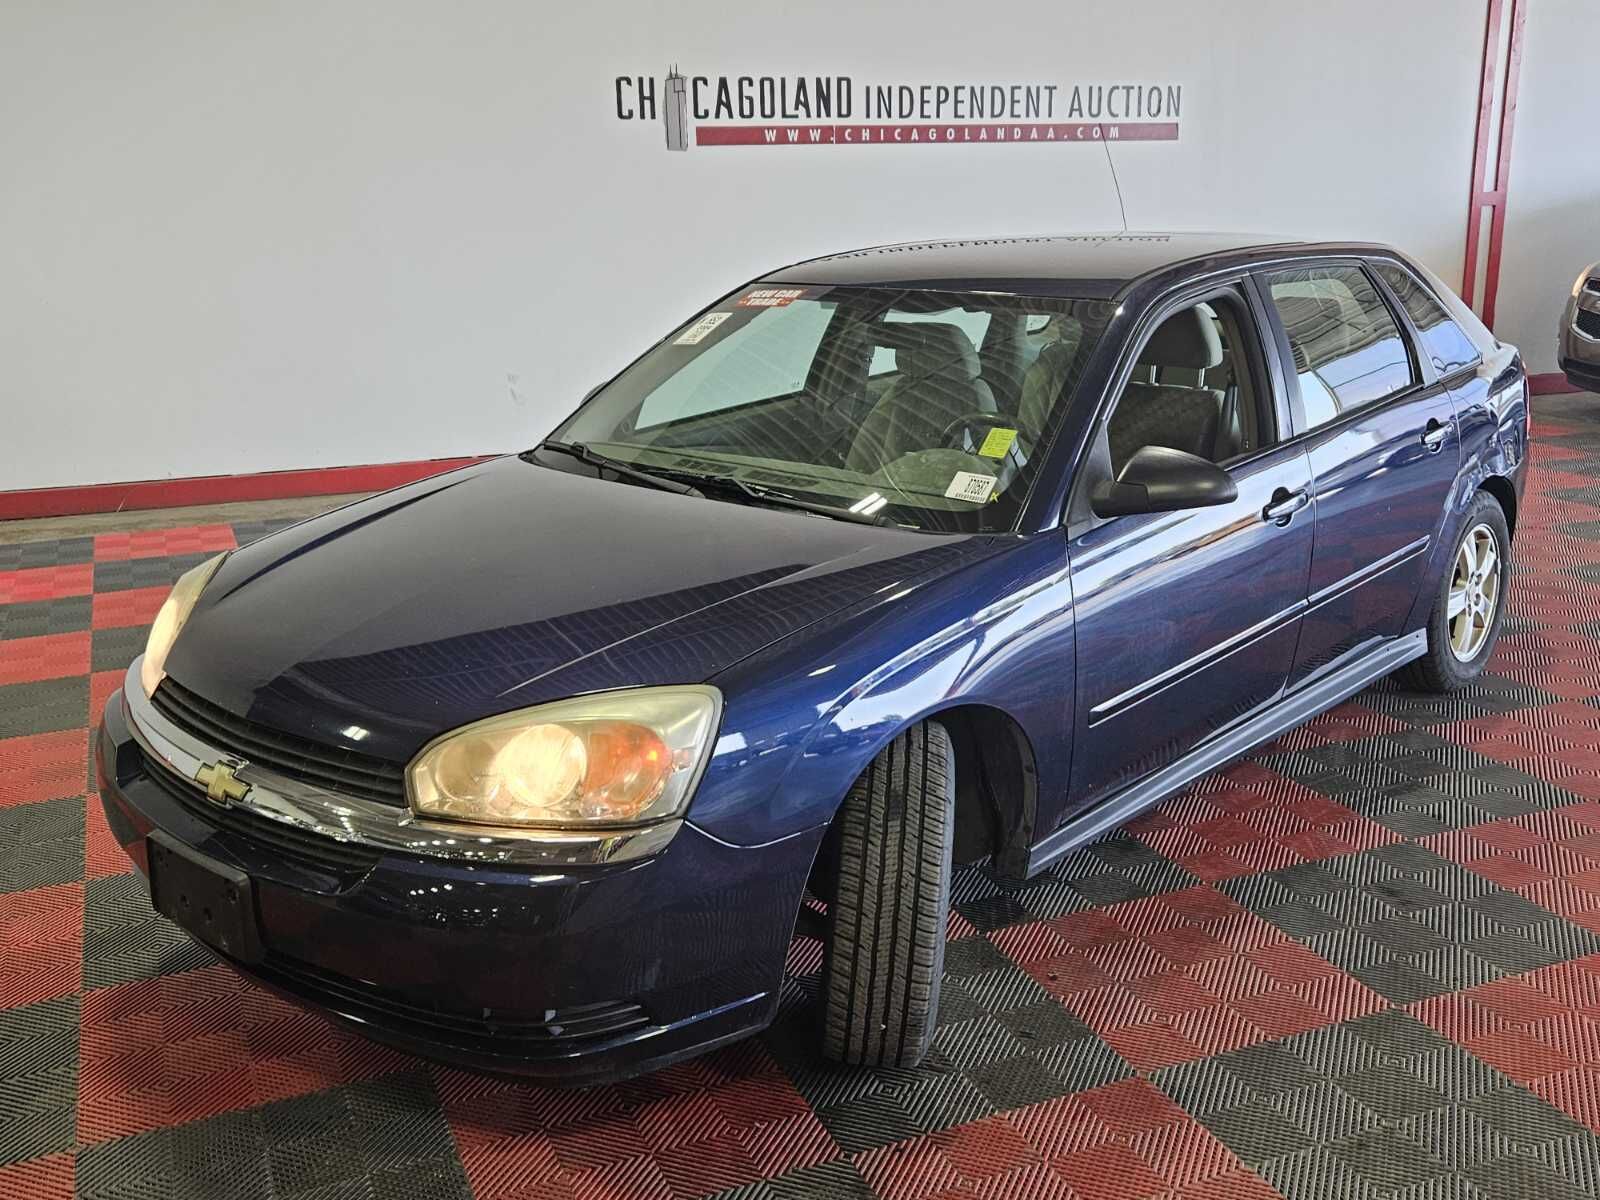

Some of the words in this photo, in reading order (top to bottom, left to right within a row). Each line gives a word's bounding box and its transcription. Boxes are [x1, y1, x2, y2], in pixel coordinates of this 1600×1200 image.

[866, 85, 1057, 119] INDEPENDENT
[1068, 85, 1181, 118] AUCTION
[764, 126, 1120, 143] WWW.CHICAGOLANDAA.COM
